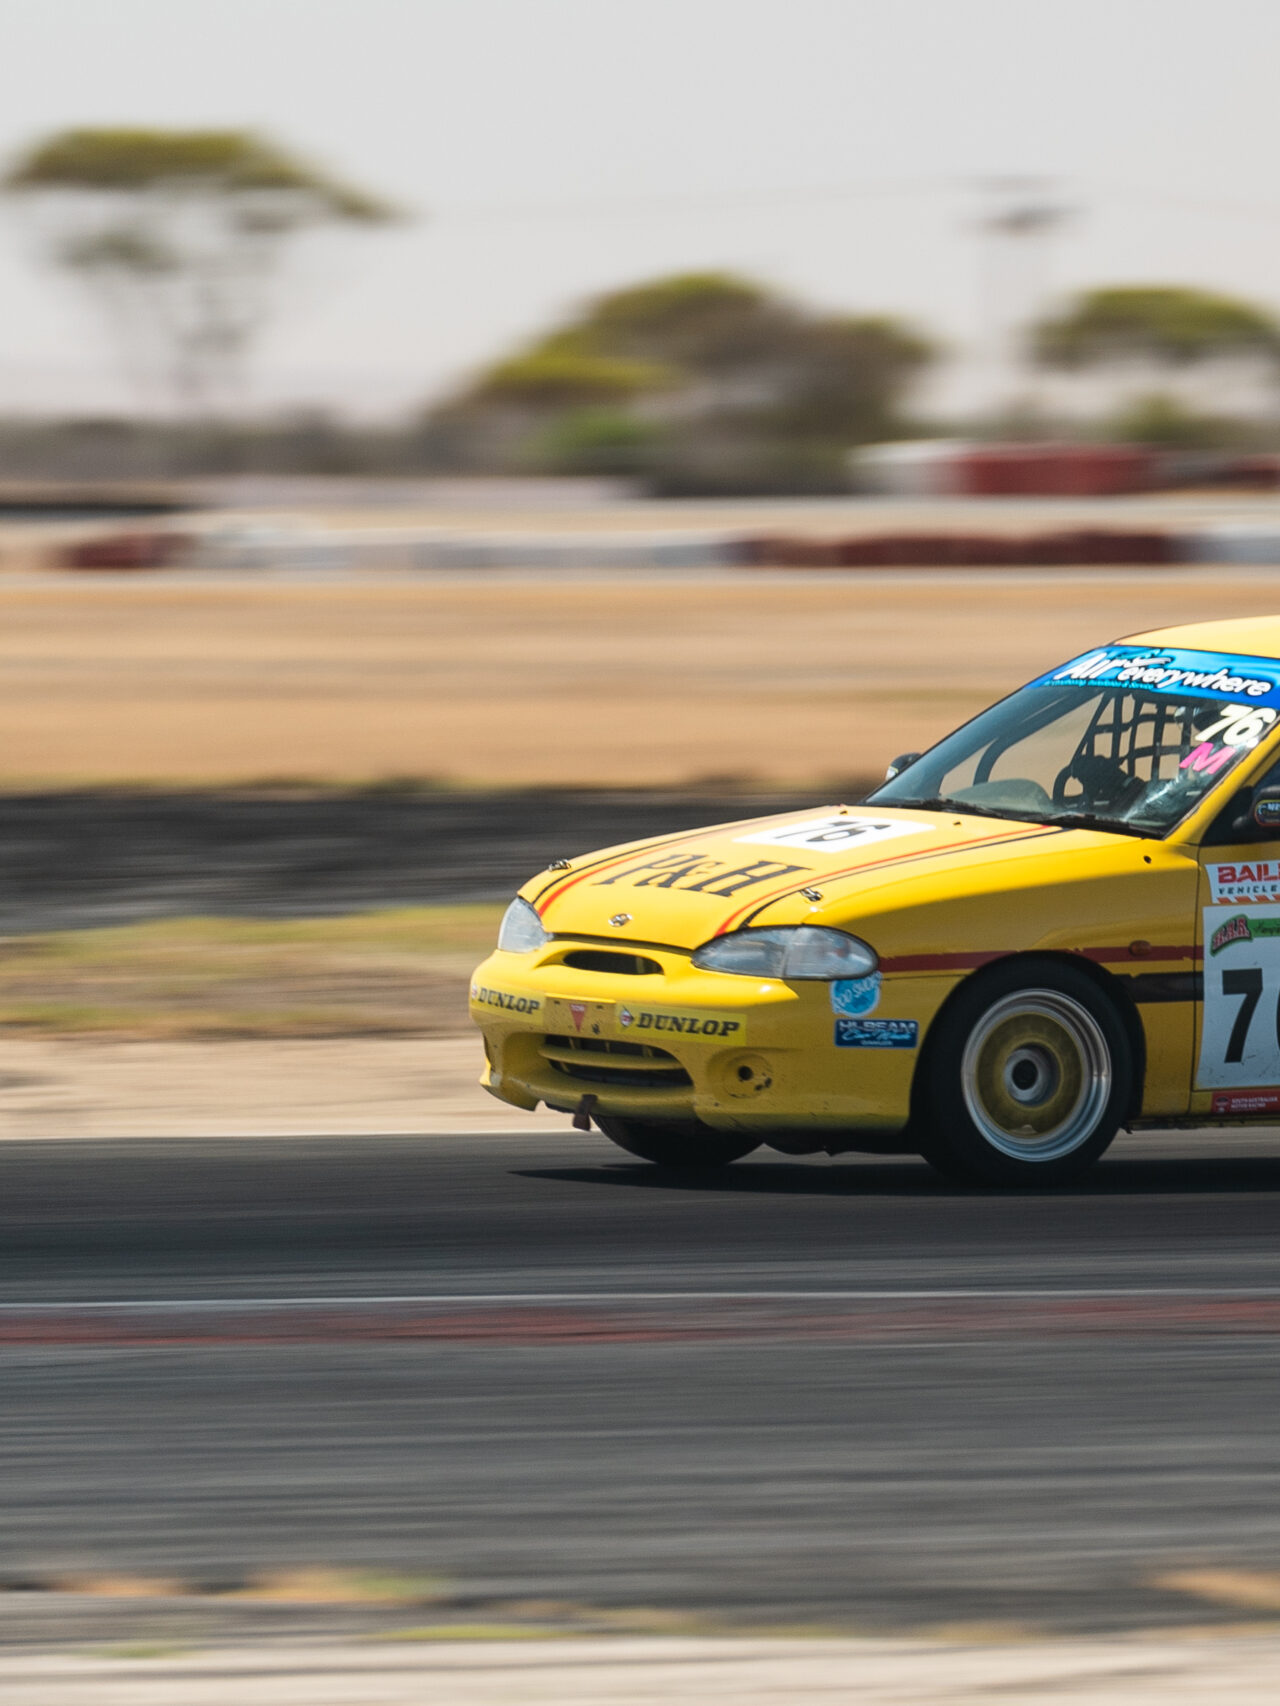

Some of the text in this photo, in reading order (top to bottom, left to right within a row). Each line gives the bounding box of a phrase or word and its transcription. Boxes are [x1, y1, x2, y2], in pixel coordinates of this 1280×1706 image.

[1117, 667, 1273, 697] everywhere
[1195, 704, 1277, 746] 76
[1179, 742, 1236, 775] M
[774, 820, 892, 843] 76
[590, 853, 815, 897] P&H
[1219, 883, 1277, 895] VEHICLE
[477, 987, 540, 1015] DUNLOP
[636, 1012, 740, 1037] DUNLOP
